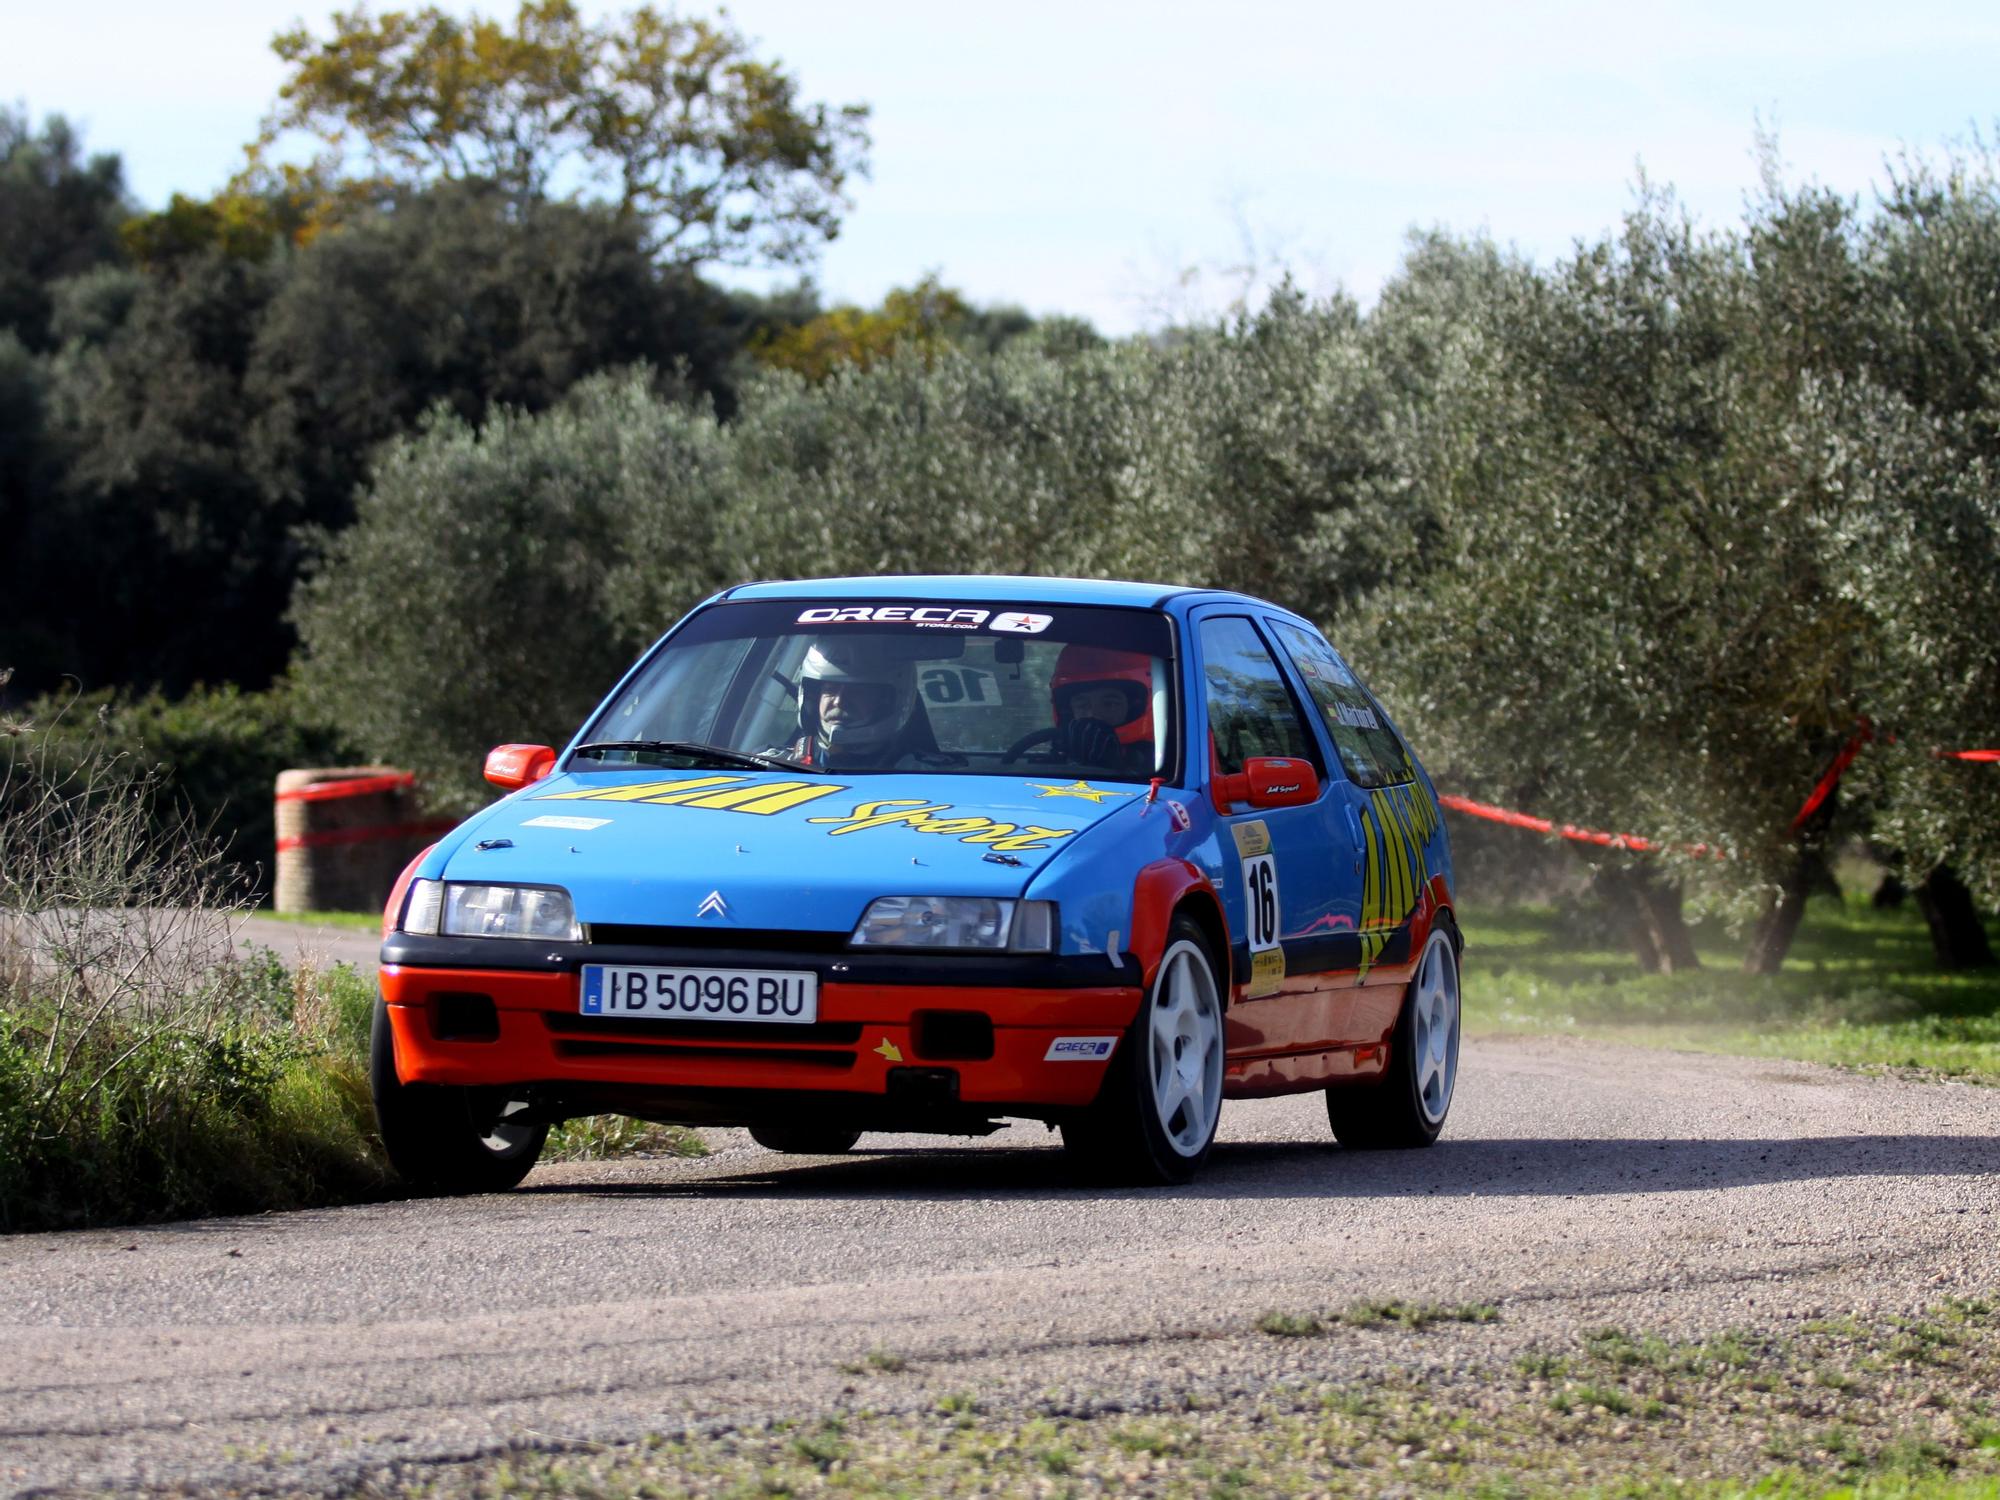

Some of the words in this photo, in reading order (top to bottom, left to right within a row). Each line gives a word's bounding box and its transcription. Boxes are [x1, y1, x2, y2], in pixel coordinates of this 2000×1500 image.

[797, 607, 991, 624] ORECA
[915, 622, 979, 630] STORE.COM
[806, 799, 1078, 852] Sport
[1248, 860, 1275, 945] 16
[588, 994, 598, 1006] E
[610, 971, 648, 1011] IB
[656, 973, 749, 1014] 5096
[756, 977, 805, 1017] BU
[1054, 1042, 1097, 1051] ORECA
